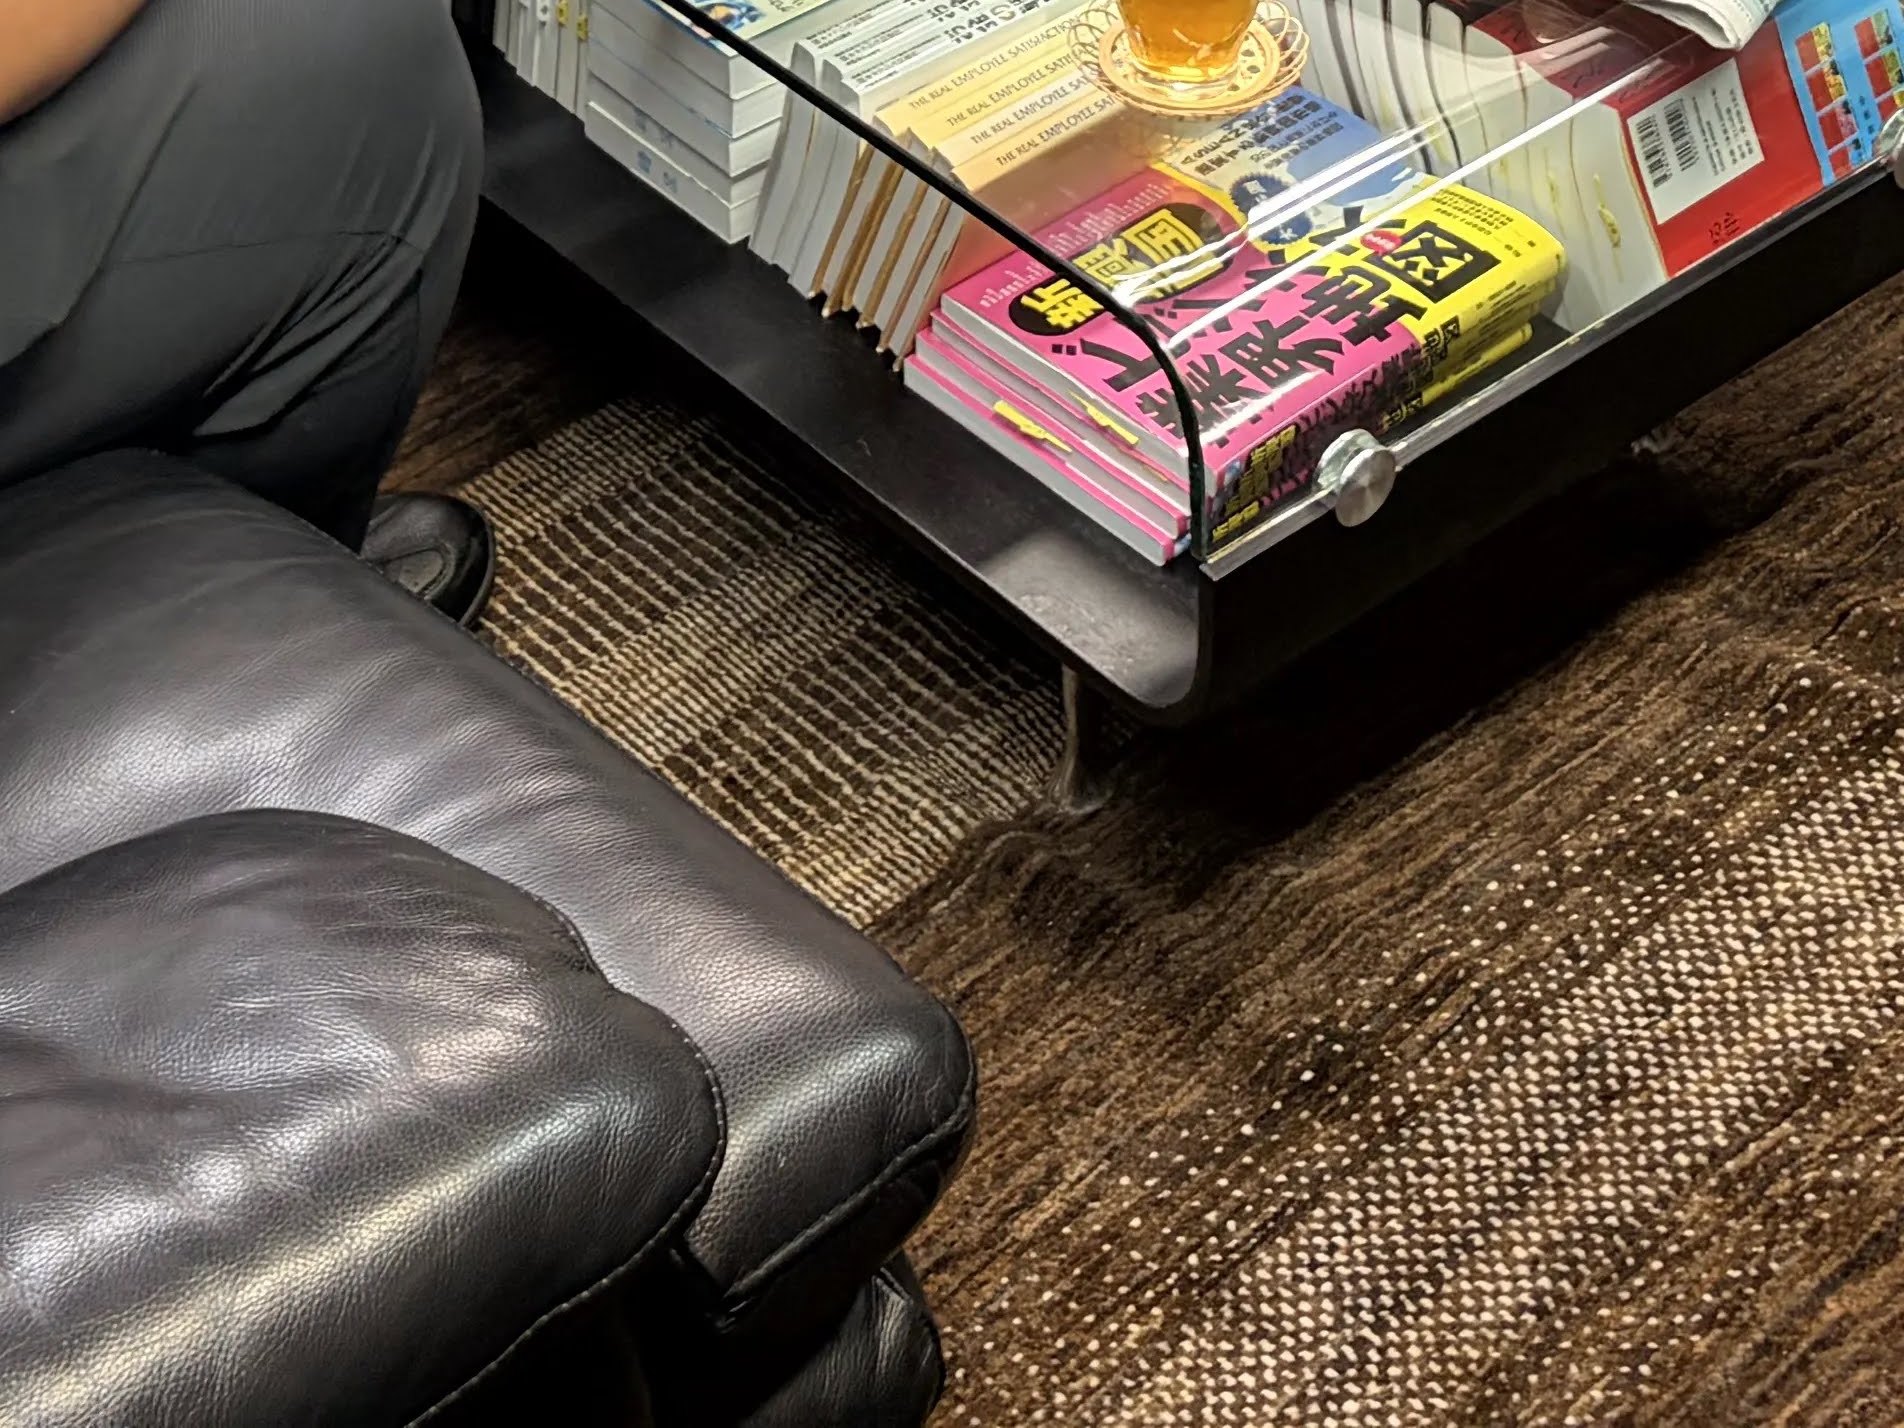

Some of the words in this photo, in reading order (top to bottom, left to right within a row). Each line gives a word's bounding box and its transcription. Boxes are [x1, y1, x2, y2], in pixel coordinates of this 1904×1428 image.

[911, 96, 928, 111] THE
[928, 82, 952, 104] REAL
[952, 53, 1009, 88] EMPLOYEE
[946, 114, 966, 128] THE
[968, 99, 991, 117] REAL
[990, 69, 1047, 104] EMPLOYEE
[971, 130, 991, 145] THE
[992, 116, 1015, 134] REAL
[1013, 85, 1068, 120] EMPLOYEE
[996, 152, 1017, 167] THE
[1017, 139, 1040, 155] REAL
[1038, 106, 1095, 142] EMPLOYEE
[1136, 220, 1500, 441] 業界地図
